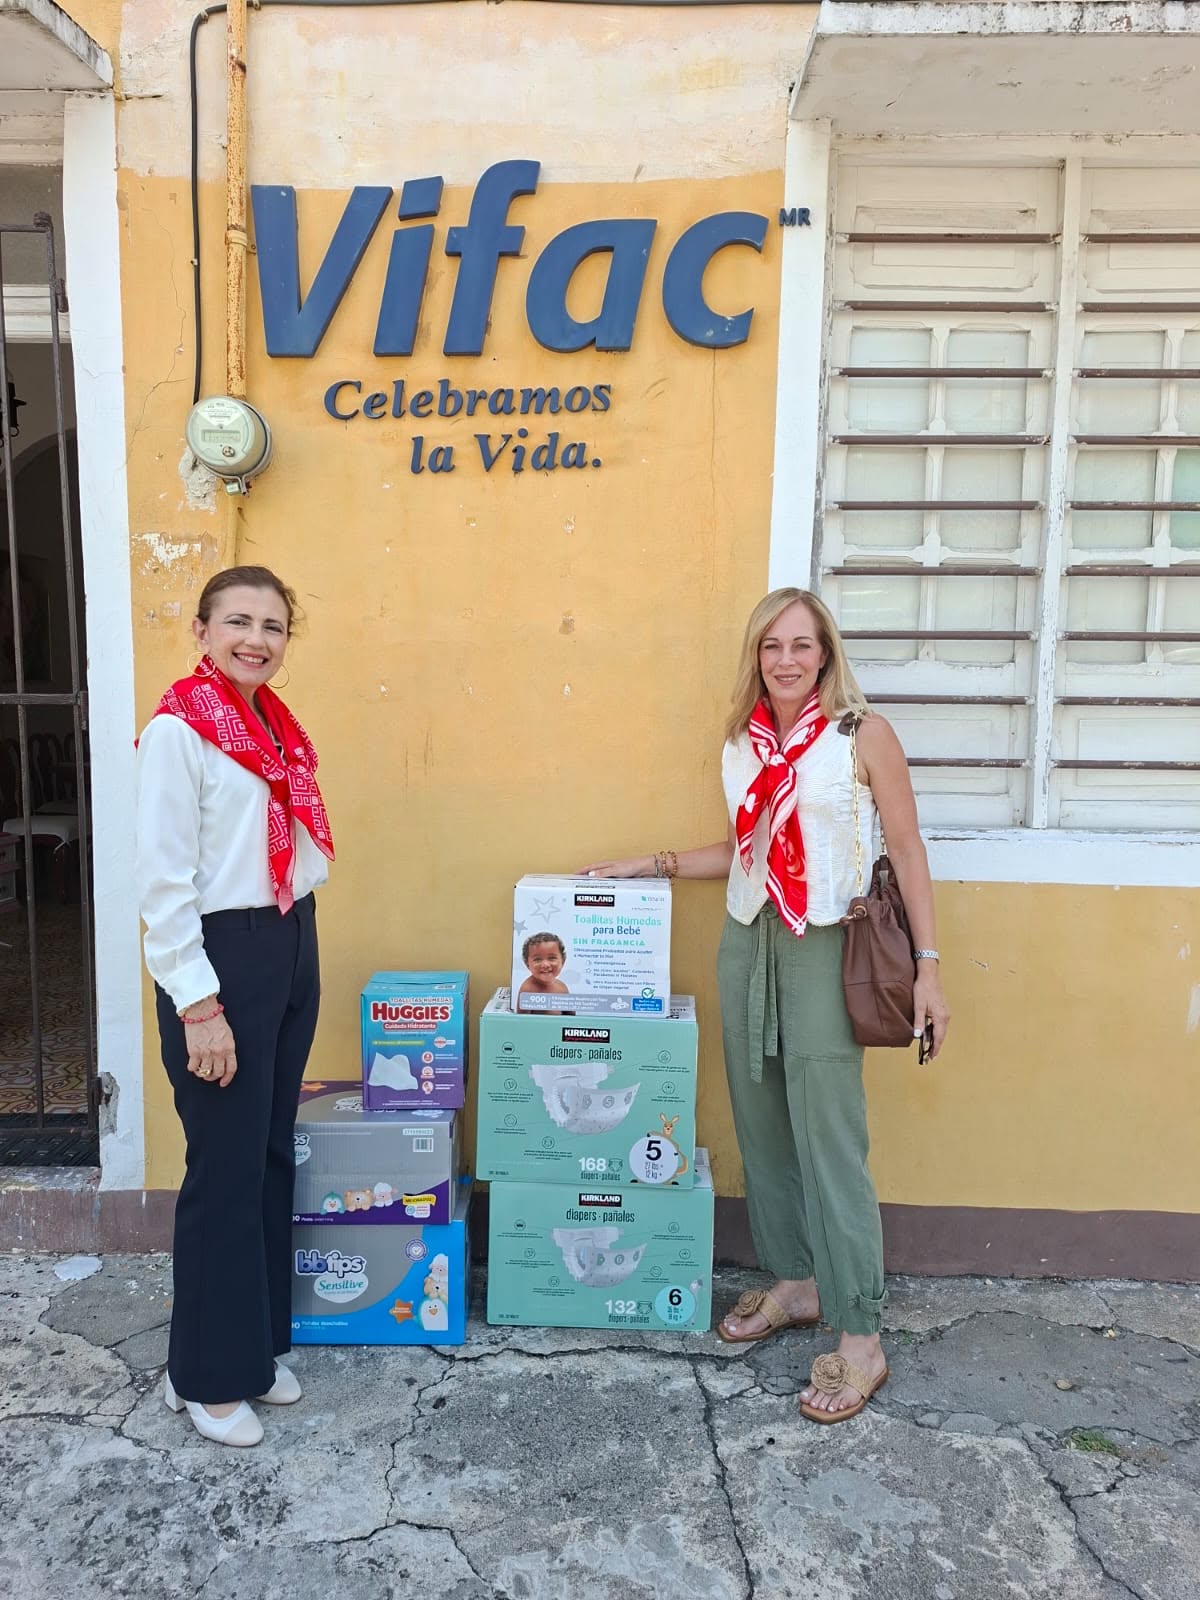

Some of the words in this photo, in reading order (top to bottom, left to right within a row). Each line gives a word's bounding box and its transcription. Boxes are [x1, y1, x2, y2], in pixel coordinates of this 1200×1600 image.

[779, 208, 811, 227] MR
[251, 159, 769, 358] Vifac
[323, 378, 612, 421] Celebramos
[410, 435, 456, 474] la
[473, 427, 602, 473] Vida.
[576, 895, 614, 903] KIRKLAND
[574, 914, 614, 924] Toallitas
[592, 926, 614, 936] para
[616, 925, 641, 935] Bebé
[591, 938, 646, 947] FRAGANCIA
[530, 995, 547, 1003] 900
[372, 1002, 450, 1021] HUGGIES
[564, 1029, 609, 1038] KIRKLAND
[550, 1046, 583, 1060] diapers
[588, 1047, 622, 1061] pañales
[645, 1139, 662, 1161] 5
[578, 1157, 607, 1172] 168
[580, 1171, 599, 1181] diapers
[581, 1194, 621, 1203] KIRKLAND
[566, 1208, 597, 1222] diapers
[602, 1210, 635, 1223] pañales
[297, 1251, 364, 1278] bbtips
[318, 1279, 364, 1291] Sensitive
[668, 1288, 682, 1306] 6
[604, 1299, 637, 1314] 132
[608, 1314, 627, 1323] diapers
